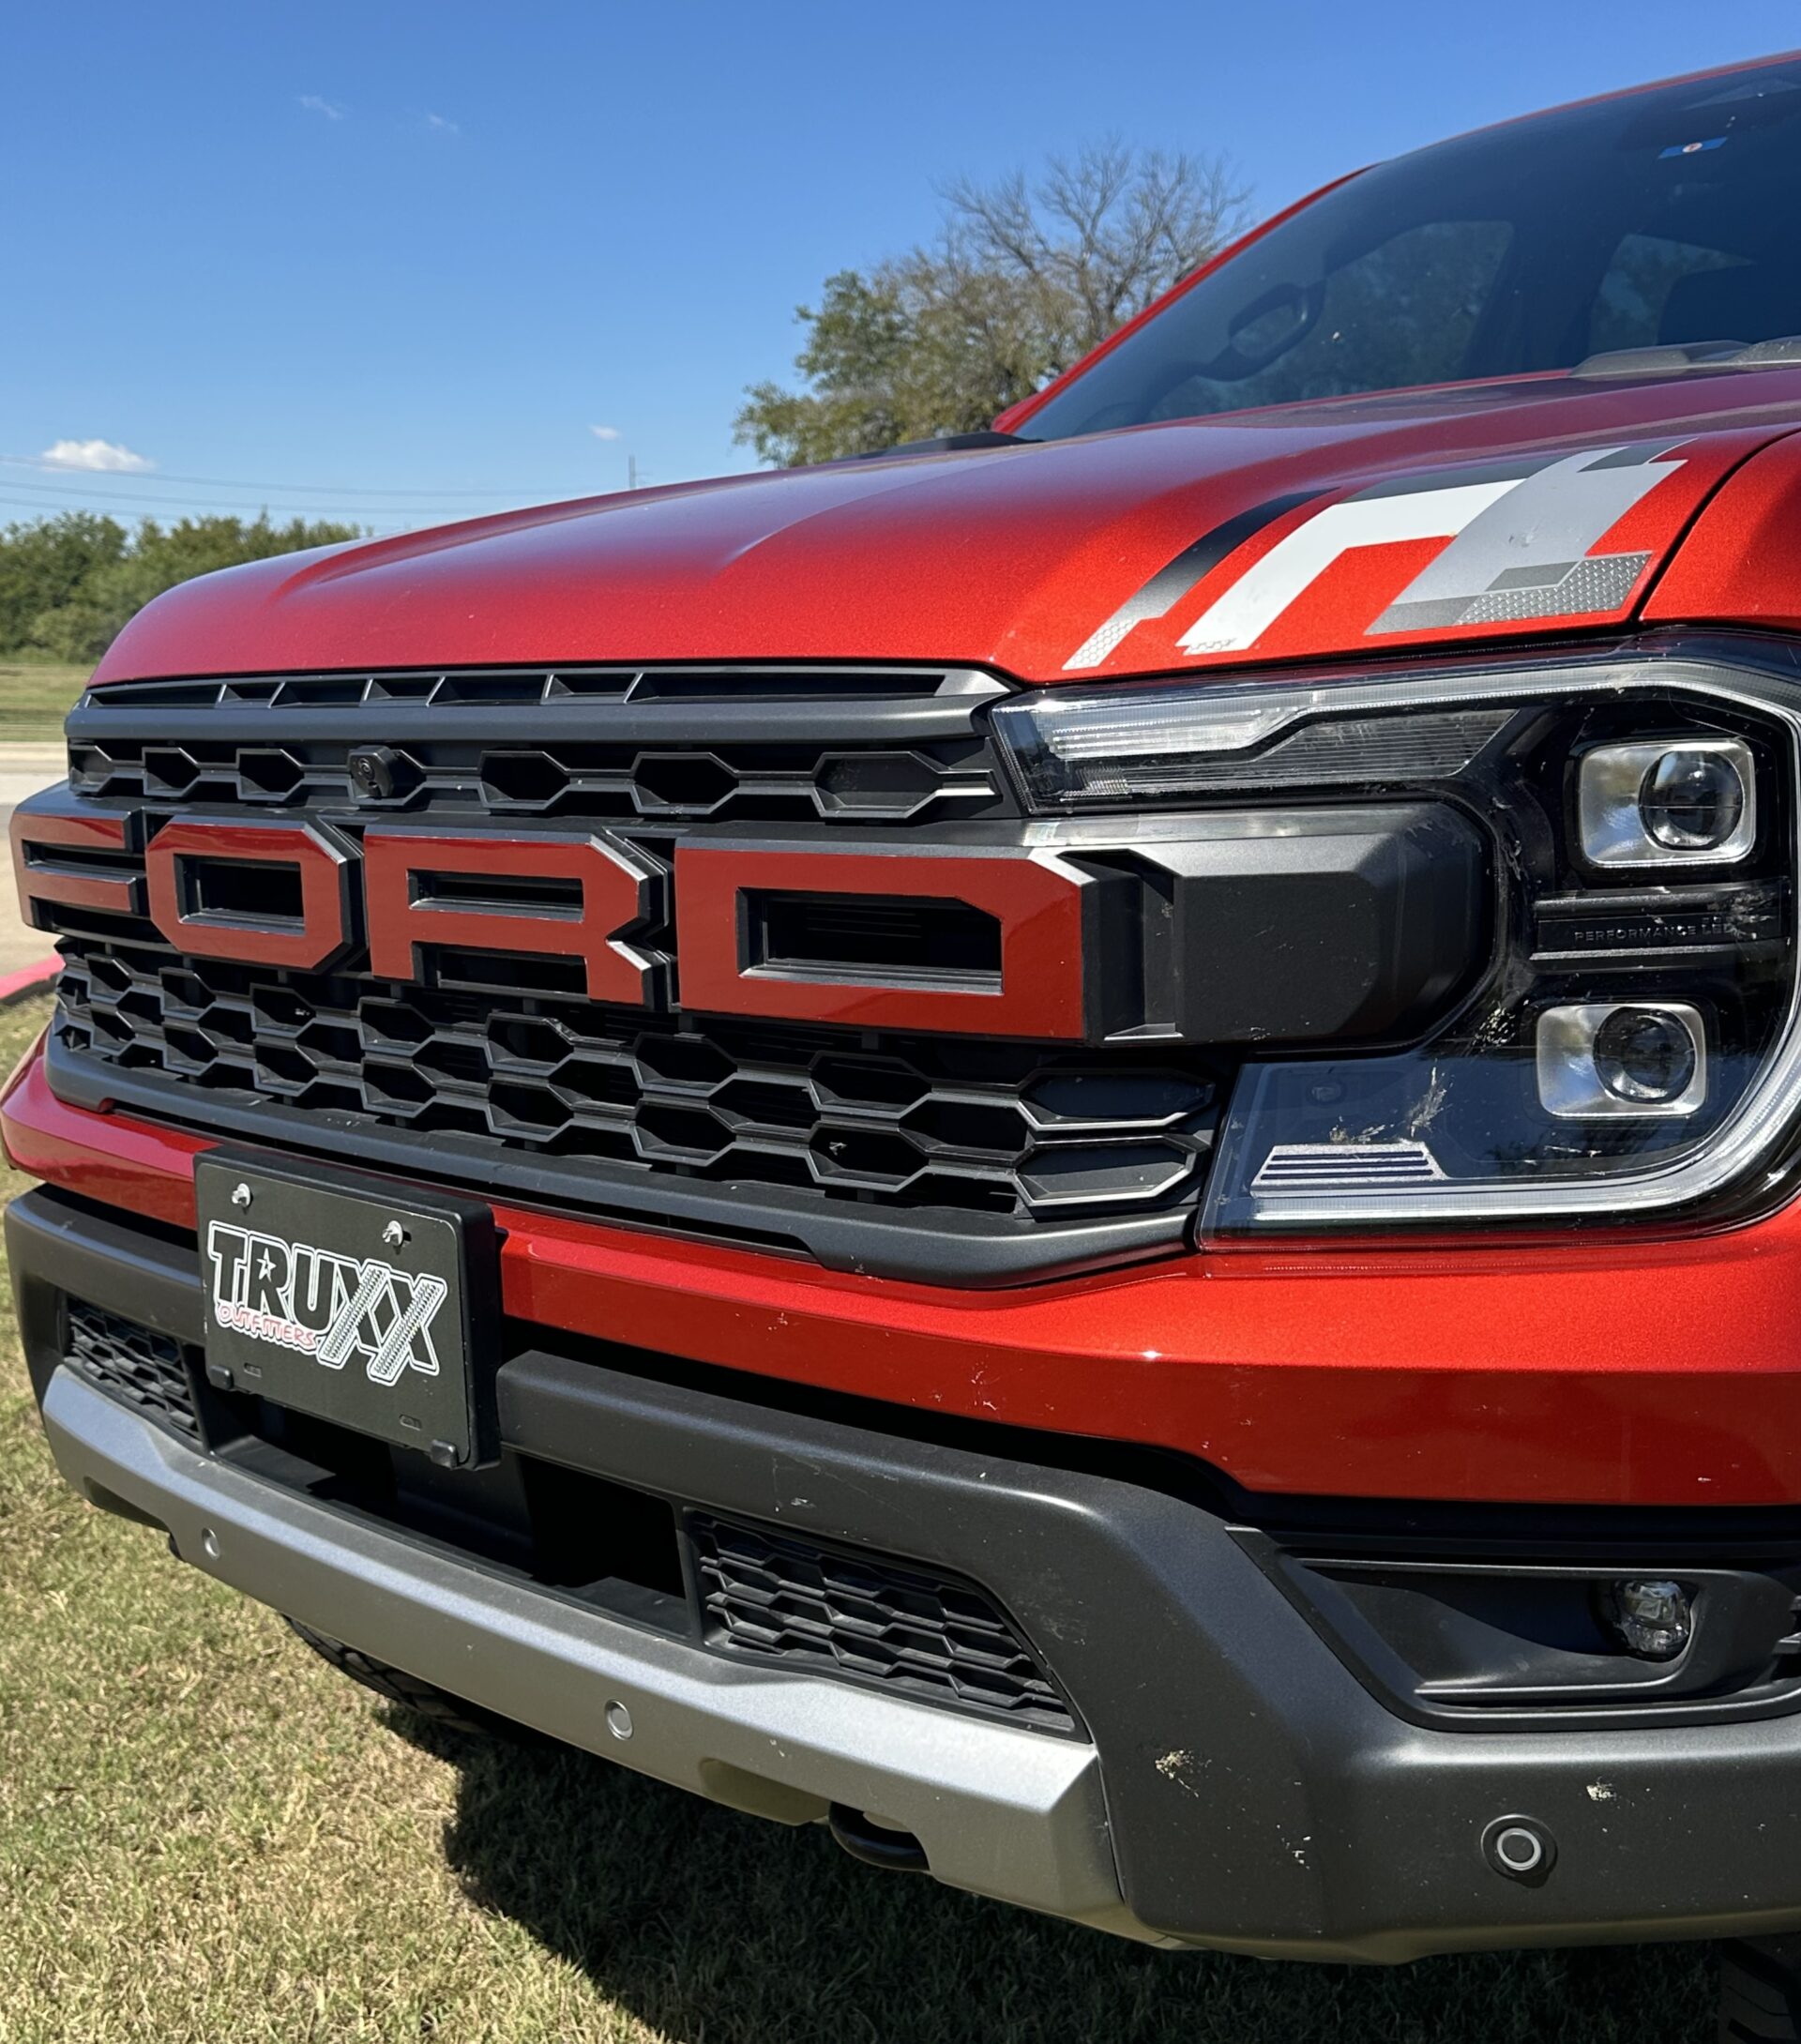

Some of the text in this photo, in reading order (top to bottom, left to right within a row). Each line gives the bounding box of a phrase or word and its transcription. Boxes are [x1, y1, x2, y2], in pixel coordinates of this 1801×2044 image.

[11, 809, 1085, 1039] FORD
[1574, 925, 1697, 941] PERFORMANCE
[208, 1220, 447, 1386] TRUXX
[219, 1304, 316, 1348] OUTFITTERS
